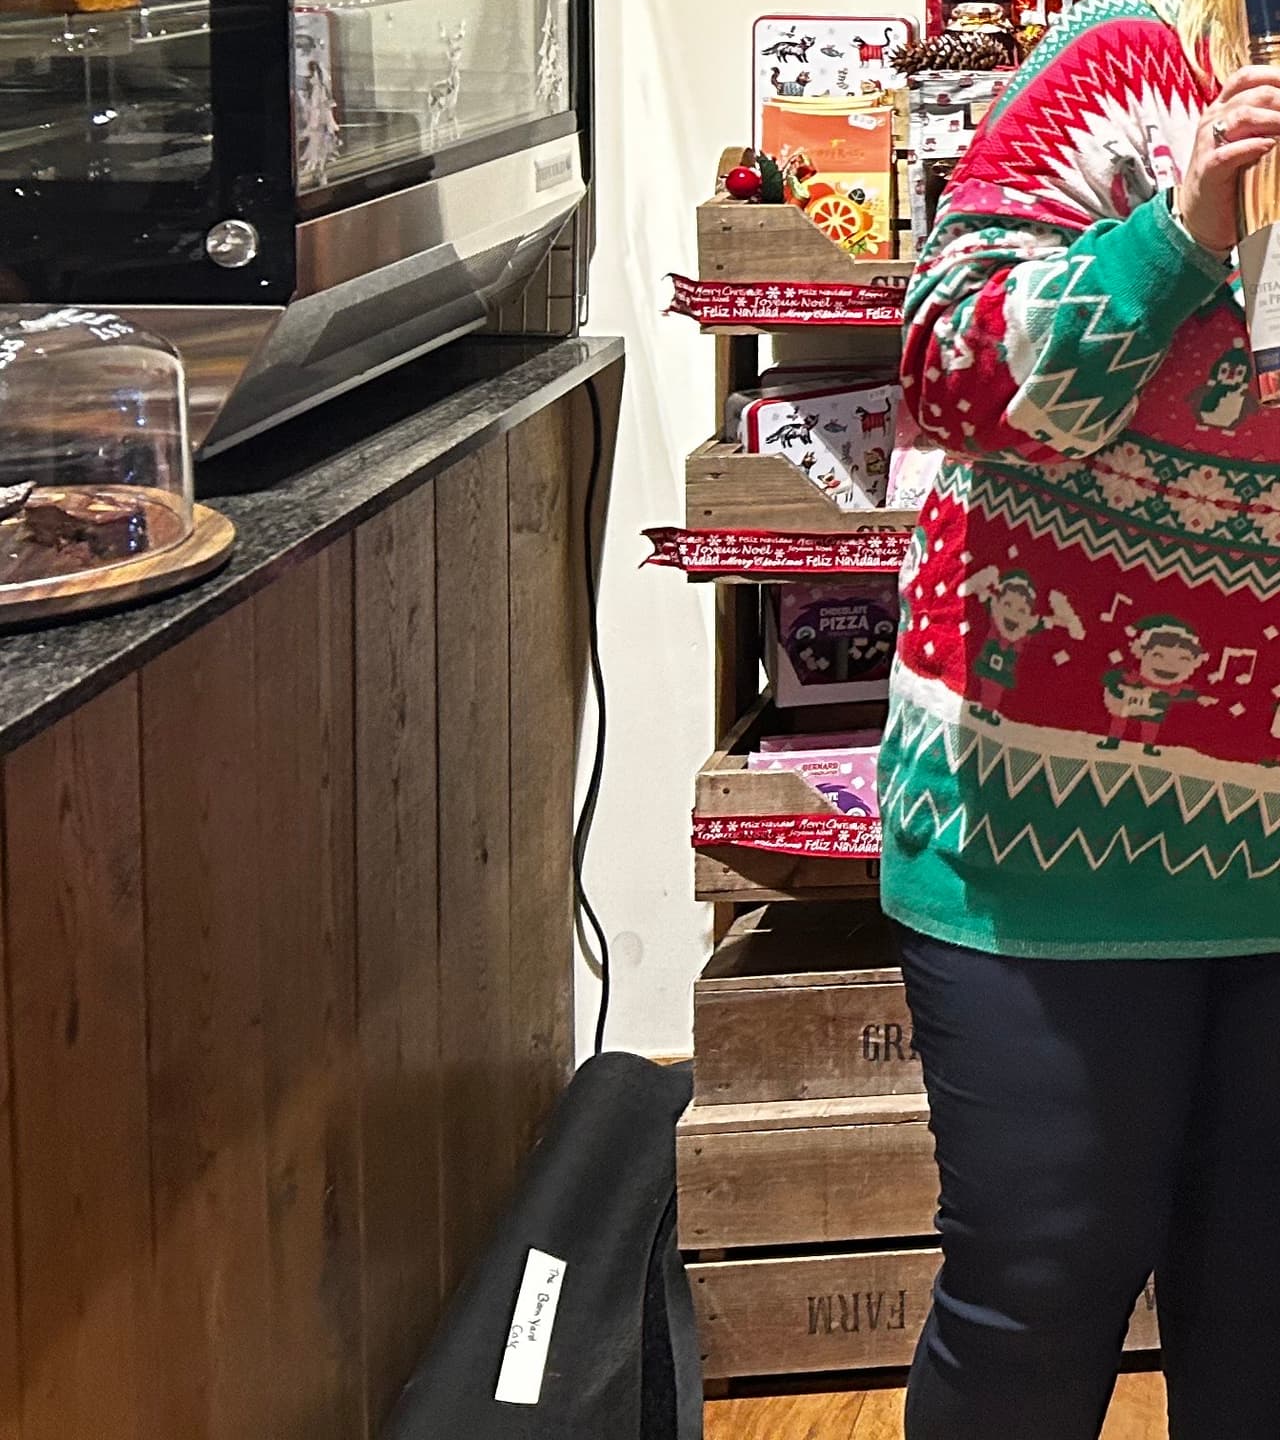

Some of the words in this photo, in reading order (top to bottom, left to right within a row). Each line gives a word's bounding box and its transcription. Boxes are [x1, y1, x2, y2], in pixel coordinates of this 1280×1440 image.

[819, 615, 870, 632] PIZZA
[802, 762, 839, 772] BERNARD
[806, 1289, 907, 1336] FARM
